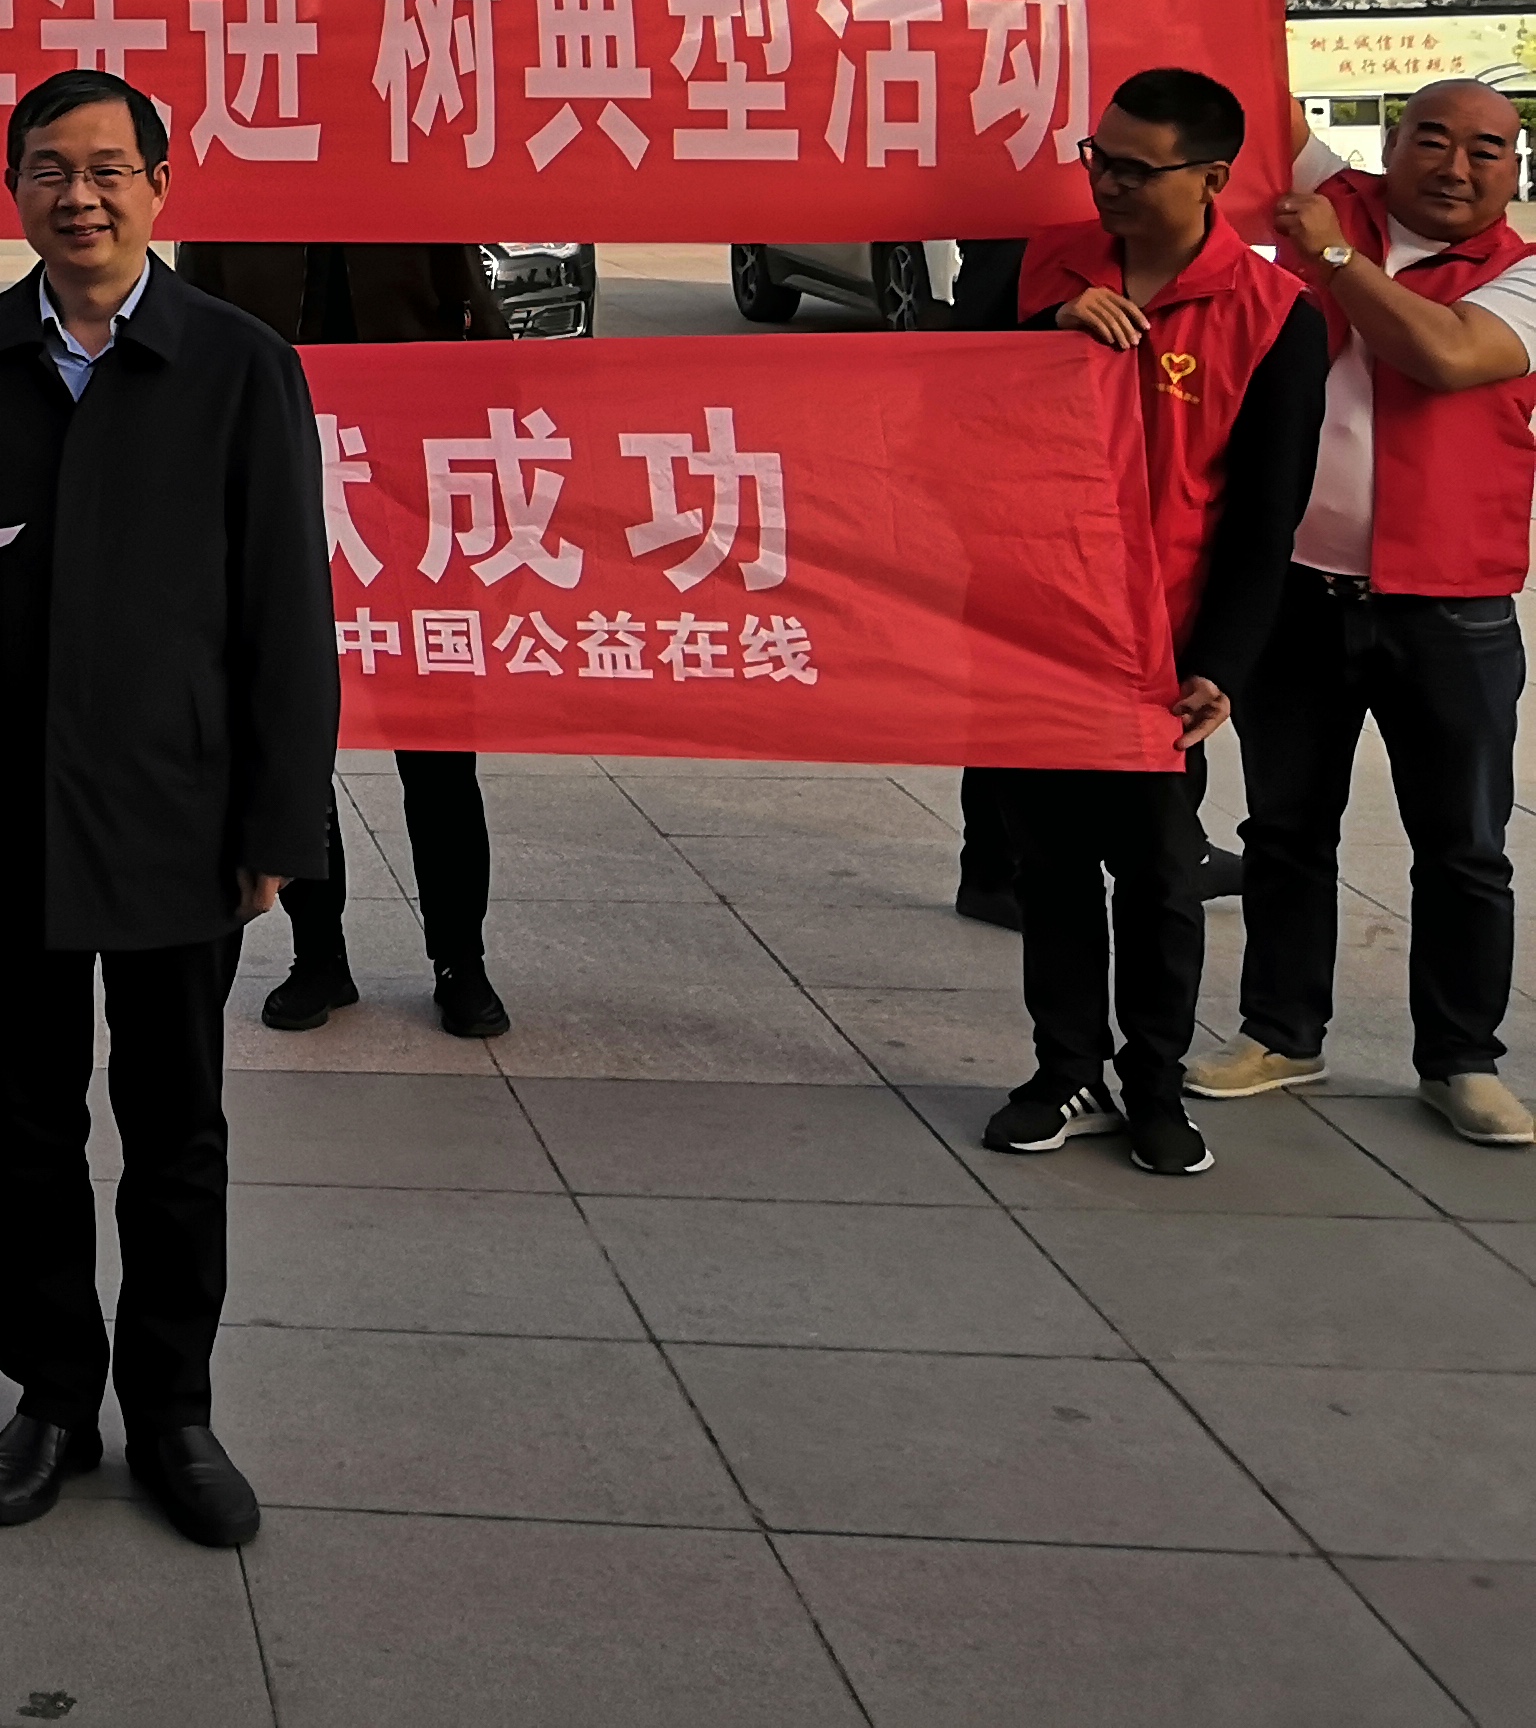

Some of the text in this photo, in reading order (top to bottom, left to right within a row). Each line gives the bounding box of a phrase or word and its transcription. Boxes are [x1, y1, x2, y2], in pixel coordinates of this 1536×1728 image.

[335, 606, 819, 685] 中国公益在线
